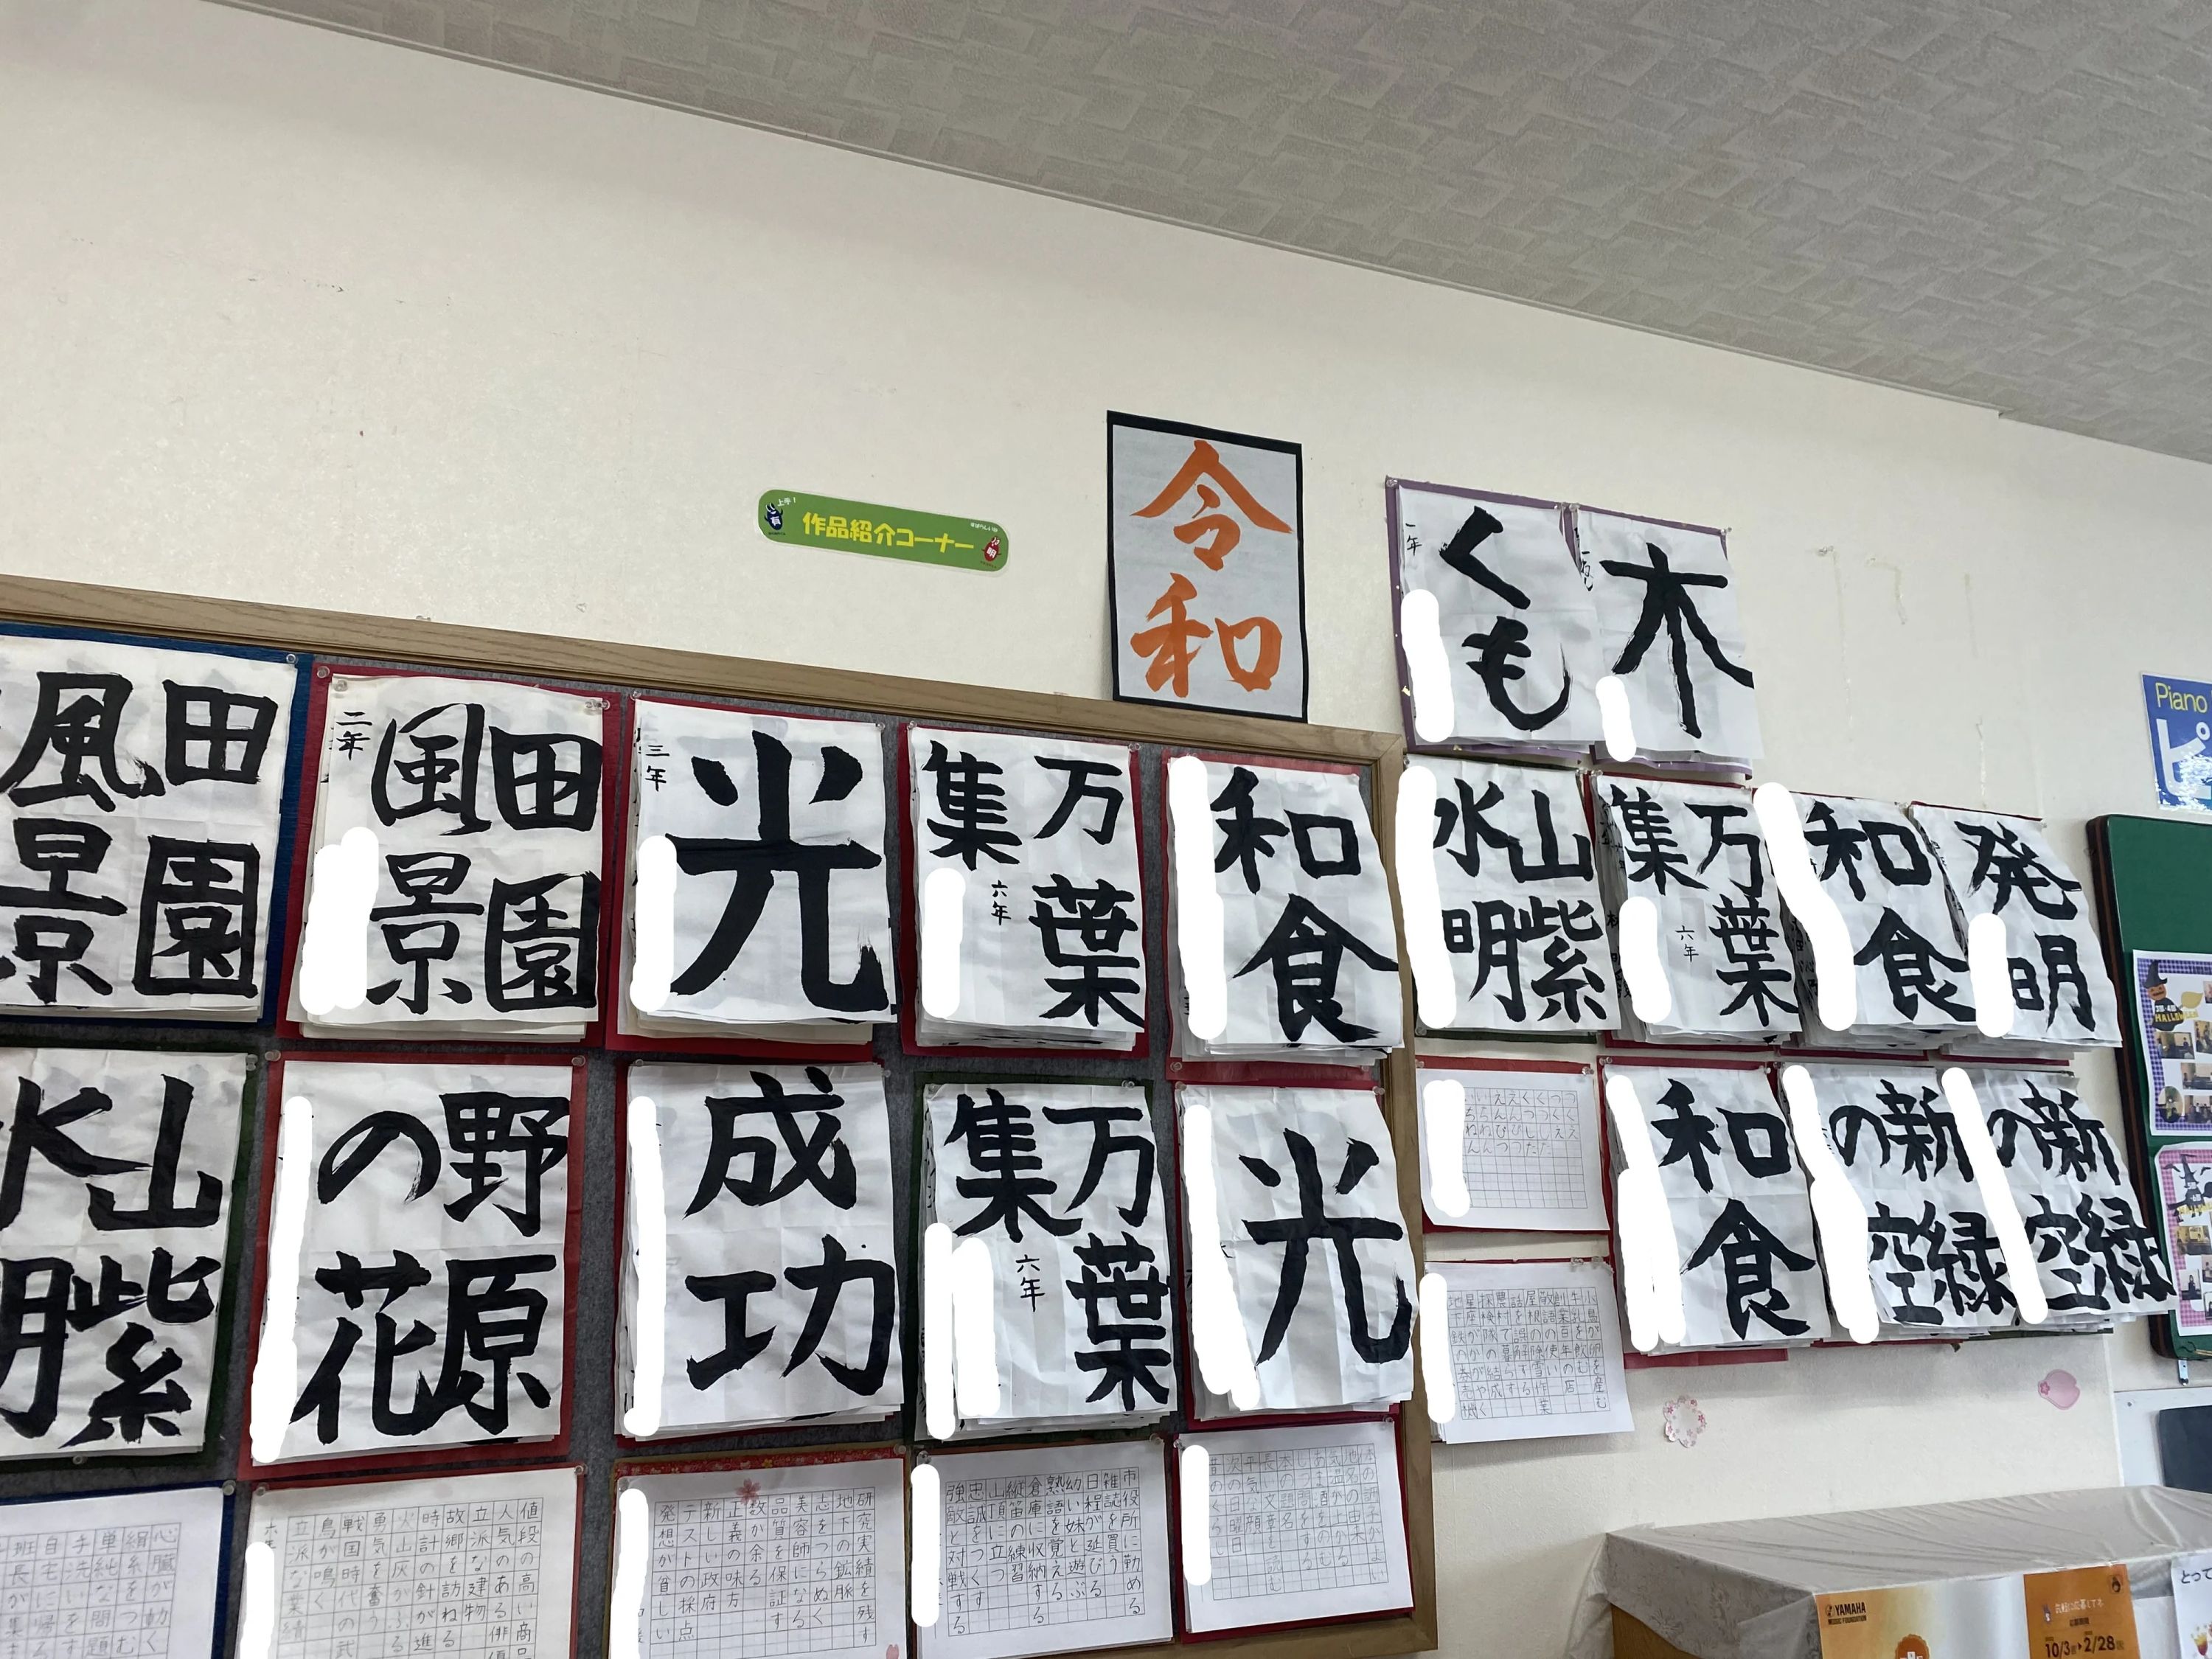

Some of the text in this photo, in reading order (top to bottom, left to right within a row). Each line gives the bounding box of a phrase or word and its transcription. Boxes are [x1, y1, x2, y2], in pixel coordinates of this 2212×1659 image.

[802, 511, 974, 553] 作品紹介コーナー
[1130, 439, 1295, 699] 令和
[1405, 523, 1422, 557] 一年
[1439, 506, 1573, 731] くも
[1599, 542, 1755, 740] 木
[334, 711, 371, 760] 二年
[644, 744, 670, 792] 三年
[922, 740, 1023, 871] 集
[2155, 682, 2208, 713] Piano
[0, 672, 165, 1004] 風景
[133, 680, 278, 999] 田園
[366, 703, 492, 1015] 風景
[484, 724, 602, 1014] 田園
[664, 730, 889, 1012] 光
[990, 879, 1012, 926] 六年
[1029, 755, 1145, 1029] 万葉
[1210, 766, 1399, 1043] 和食
[1433, 777, 1526, 1023] 水明
[1507, 789, 1608, 1023] 山紫
[1610, 784, 1709, 896] 集
[1675, 925, 1700, 963] 六年
[1684, 801, 1800, 1027] 万葉
[1804, 799, 1978, 1024] 和食
[1955, 820, 2097, 1032] 発明
[60, 1074, 223, 1449] 山紫
[289, 1110, 442, 1444] の花
[431, 1092, 570, 1434] 野原
[682, 1065, 895, 1398] 成功
[944, 1088, 1082, 1244] 集
[1042, 1105, 1172, 1411] 万葉
[1237, 1127, 1413, 1367] 光
[1650, 1078, 1817, 1340] 和食
[1874, 1079, 2020, 1330] 新緑
[2019, 1078, 2177, 1303] 新緑
[1015, 1253, 1046, 1312] 六年
[1835, 1601, 1866, 1615] YAMAHA
